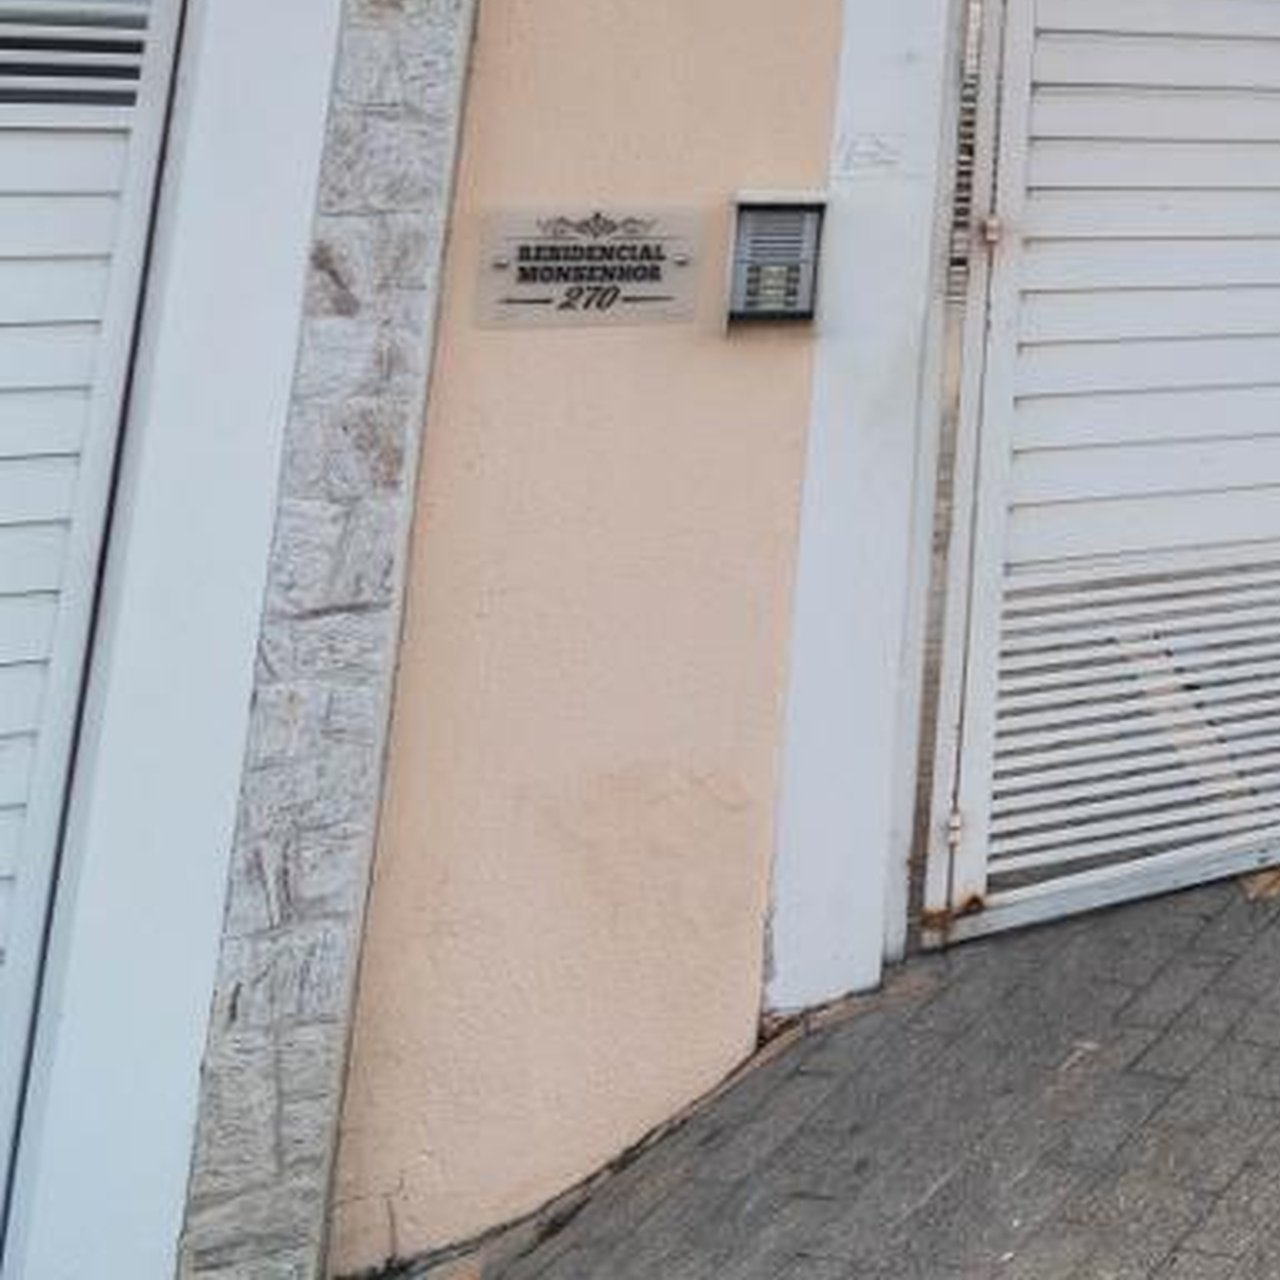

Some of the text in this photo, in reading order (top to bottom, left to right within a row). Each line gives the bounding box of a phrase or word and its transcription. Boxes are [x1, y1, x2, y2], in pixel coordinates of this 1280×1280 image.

[517, 244, 667, 262] RESIDENCIAL
[516, 264, 662, 283] MONSENHOR
[557, 284, 621, 312] 270
